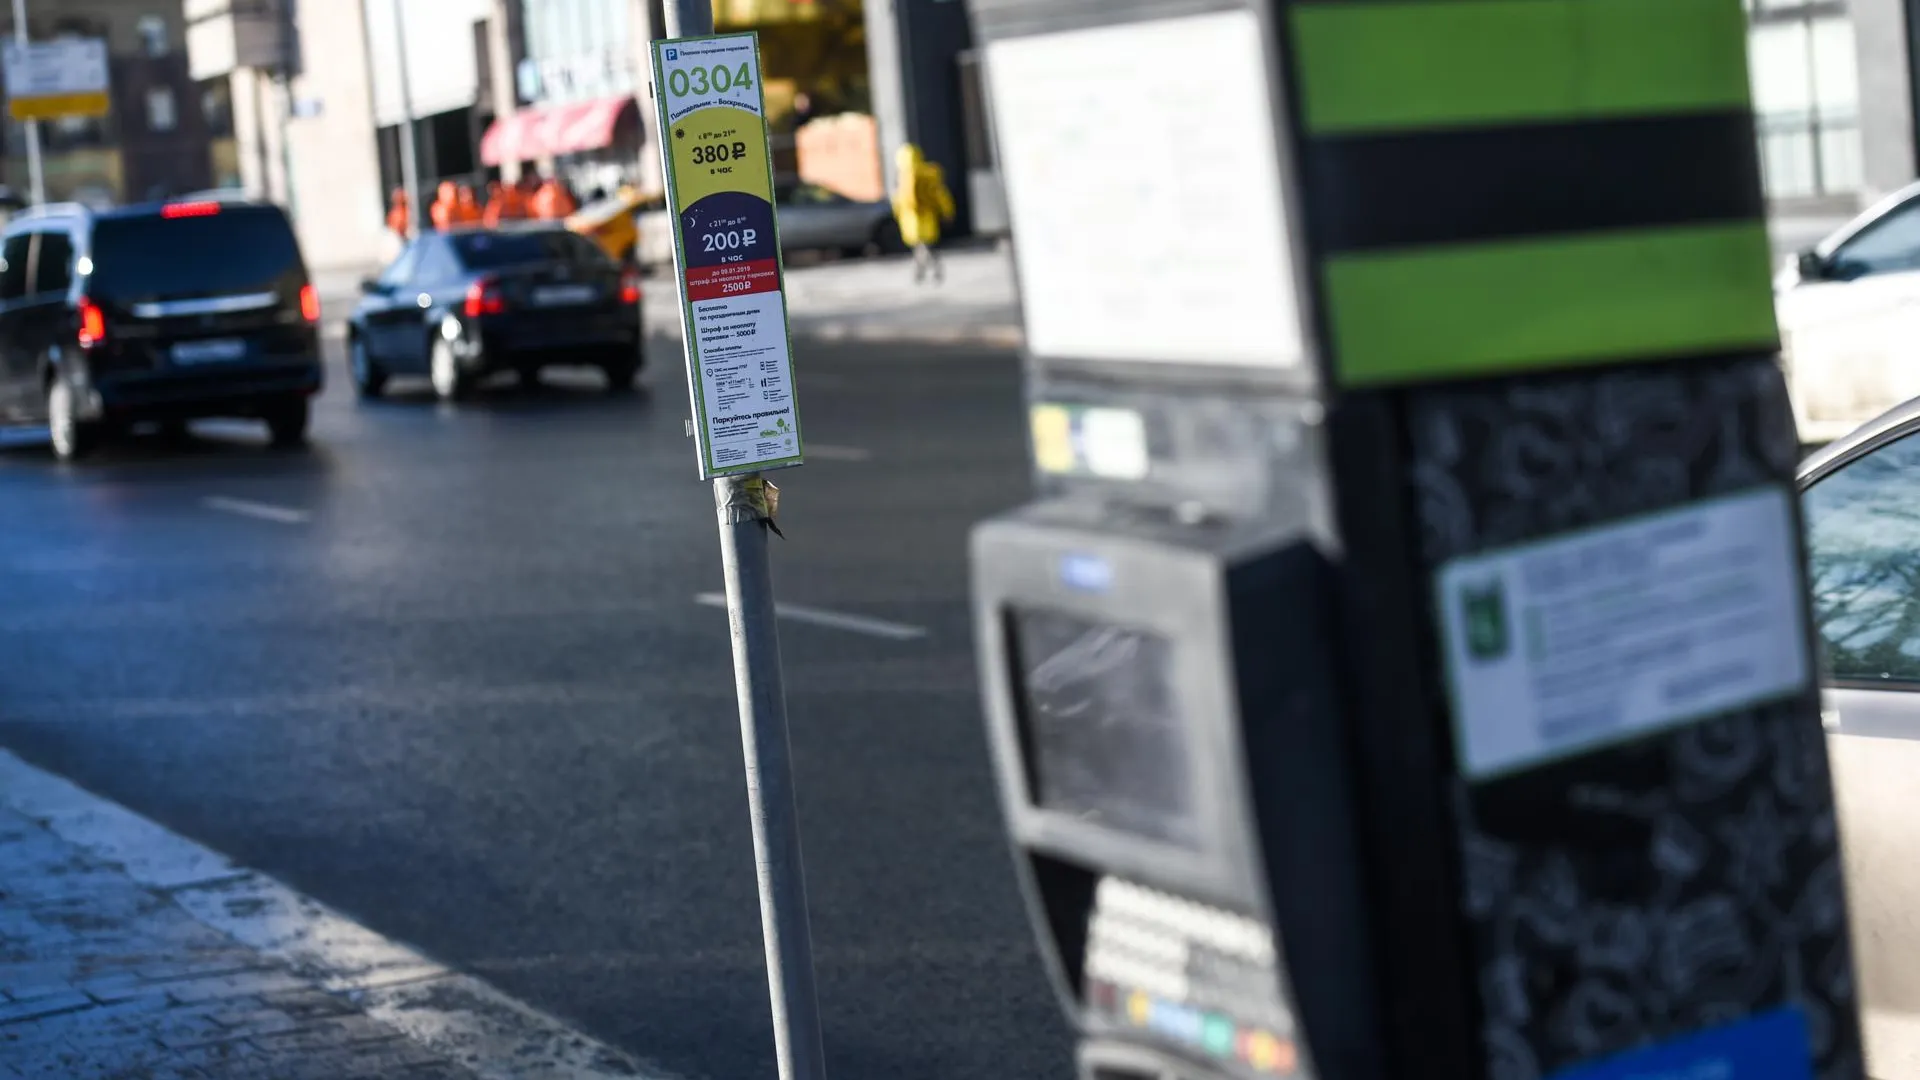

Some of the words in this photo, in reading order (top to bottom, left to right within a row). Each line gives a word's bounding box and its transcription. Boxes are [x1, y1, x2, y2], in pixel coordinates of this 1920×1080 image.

[669, 62, 753, 97] 0304
[670, 101, 712, 120] Понедельник
[718, 98, 758, 112] Воскресенье
[690, 278, 710, 286] штраф
[748, 271, 774, 279] парковки
[698, 304, 728, 313] Бесплатно
[701, 325, 721, 334] Штраф
[713, 414, 751, 424] Паркуйтесь
[752, 406, 789, 419] правильно!
